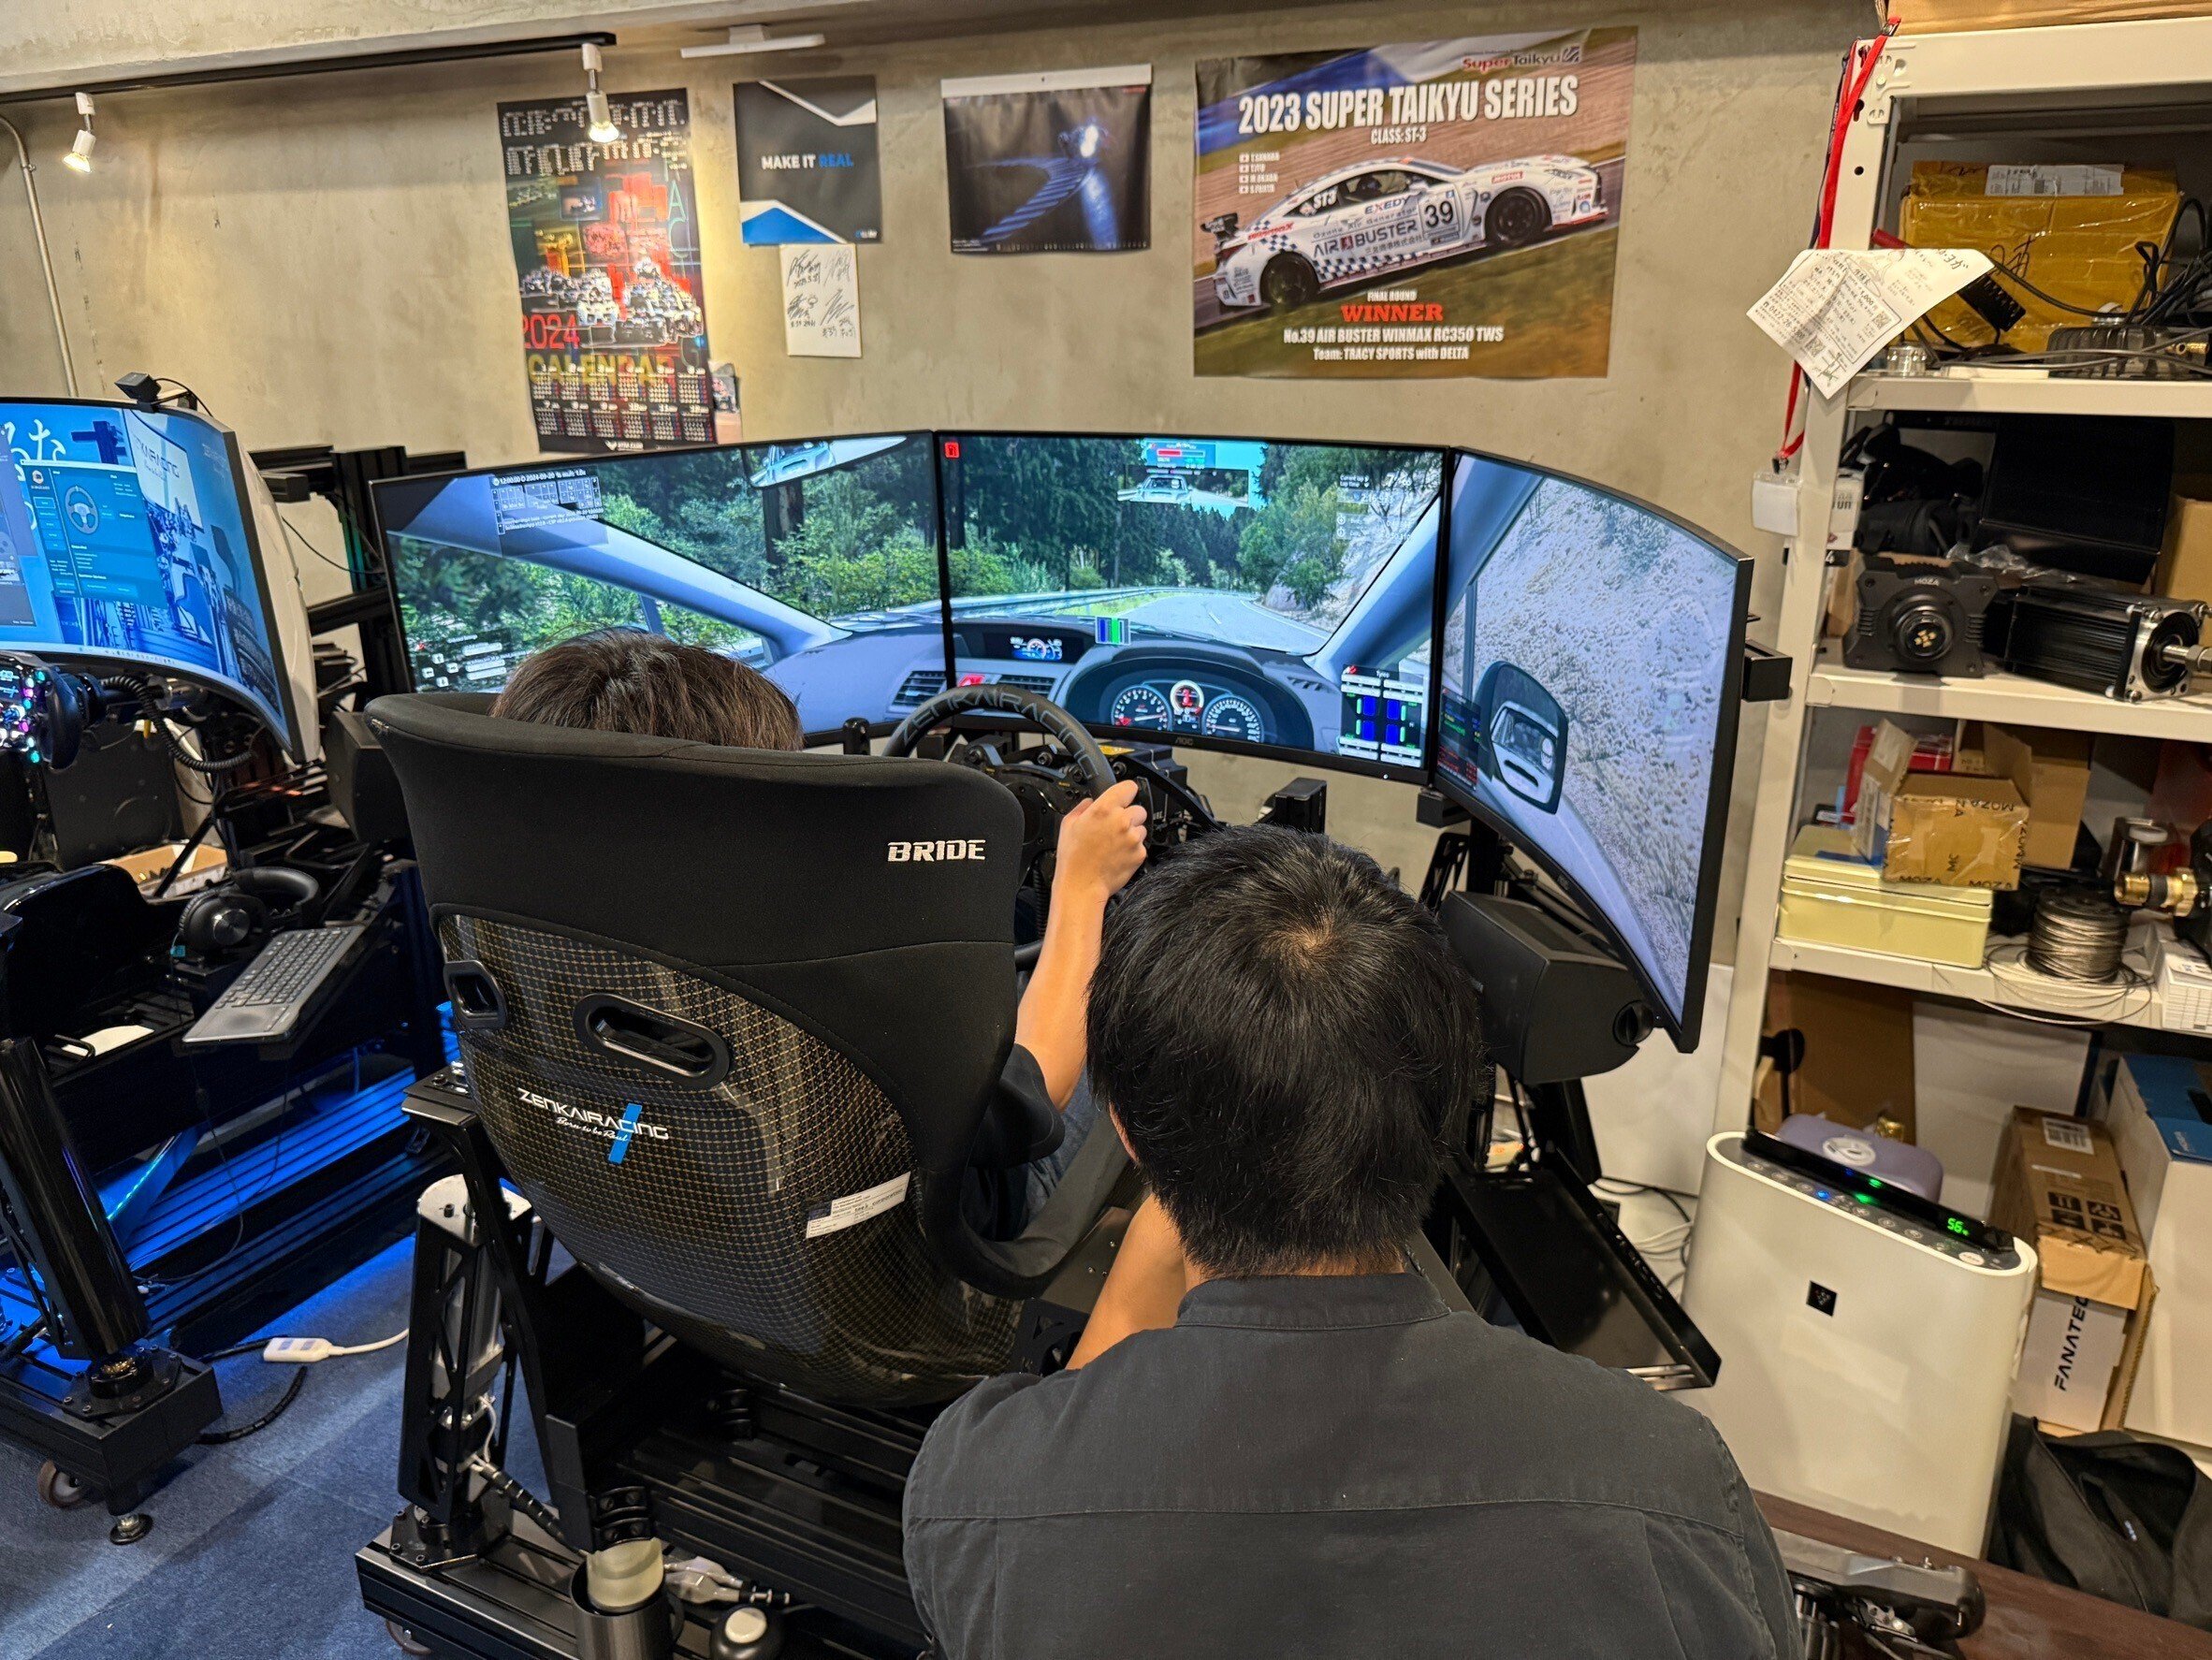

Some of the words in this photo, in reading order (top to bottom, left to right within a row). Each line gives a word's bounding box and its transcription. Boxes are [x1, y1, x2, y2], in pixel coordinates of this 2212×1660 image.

[1238, 92, 1302, 134] 2023
[1305, 86, 1385, 131] SUPER
[1389, 80, 1479, 126] TAIKYU
[1484, 74, 1579, 121] SERIES
[761, 154, 800, 169] MAKE
[803, 153, 817, 168] IT
[1313, 187, 1338, 210] ST3
[1364, 196, 1411, 214] EXEDY
[1424, 199, 1455, 229] 39
[1314, 239, 1339, 258] AIR
[1354, 219, 1419, 247] BUSTER
[1366, 290, 1389, 302] FINAL
[1340, 302, 1445, 323] WINNER
[522, 313, 581, 350] 2024
[1283, 328, 1316, 343] No.39
[1317, 328, 1335, 343] AIR
[1337, 328, 1382, 343] BUSTER
[1382, 327, 1433, 342] WINMAX
[1433, 327, 1474, 342] RC350
[1476, 326, 1505, 342] TWS
[1313, 346, 1343, 361] Team:
[1344, 346, 1375, 361] TRACY
[1375, 346, 1415, 360] SPORTS
[1416, 345, 1439, 360] with
[1440, 344, 1470, 359] DELTA
[528, 354, 677, 386] CALENDAR
[1914, 577, 1940, 587] MOZA
[887, 839, 986, 862] BRIDE
[1969, 880, 2013, 890] MOZA
[517, 1086, 670, 1141] ZENKAIRACING
[2054, 1295, 2090, 1391] FANATEC
